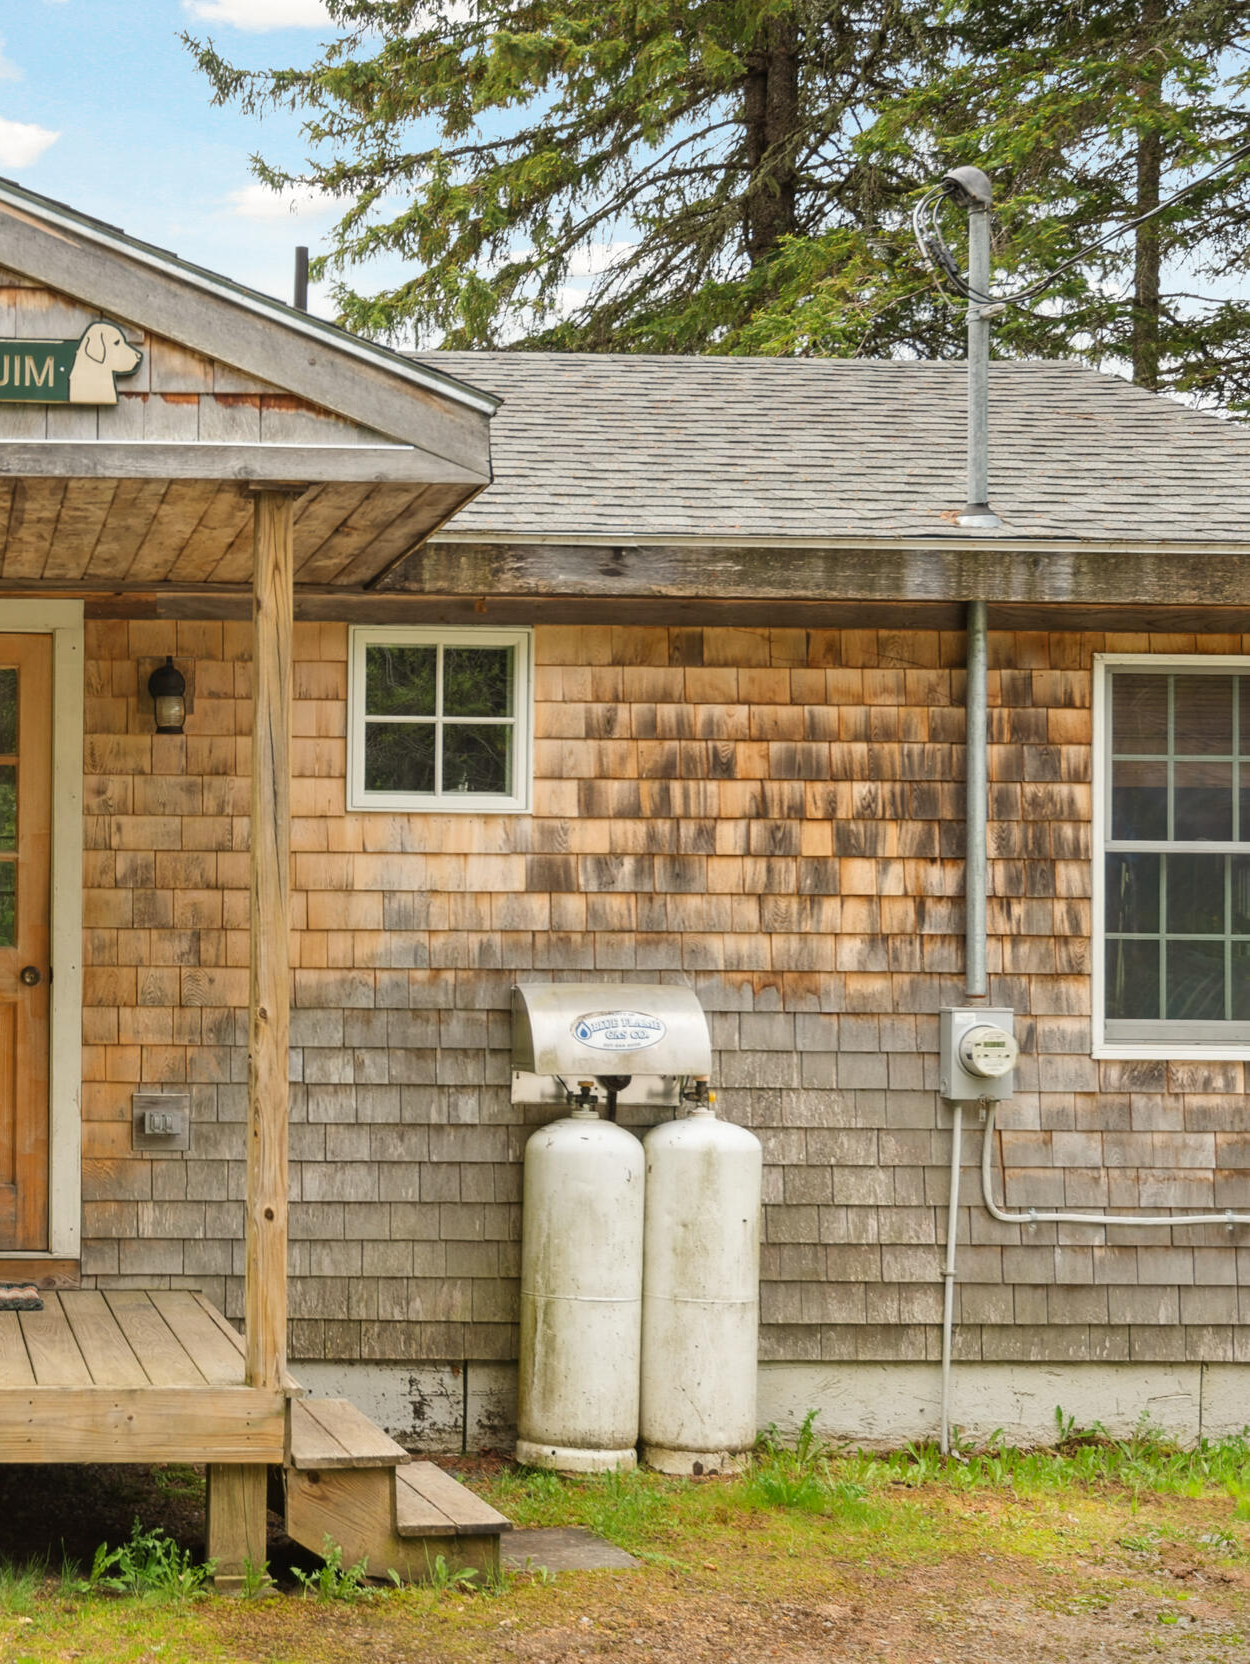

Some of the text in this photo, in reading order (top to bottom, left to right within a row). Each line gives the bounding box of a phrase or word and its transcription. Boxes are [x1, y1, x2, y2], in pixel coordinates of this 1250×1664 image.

[591, 1018, 662, 1032] BLUE FLAME
[605, 1030, 649, 1040] GAS CO.
